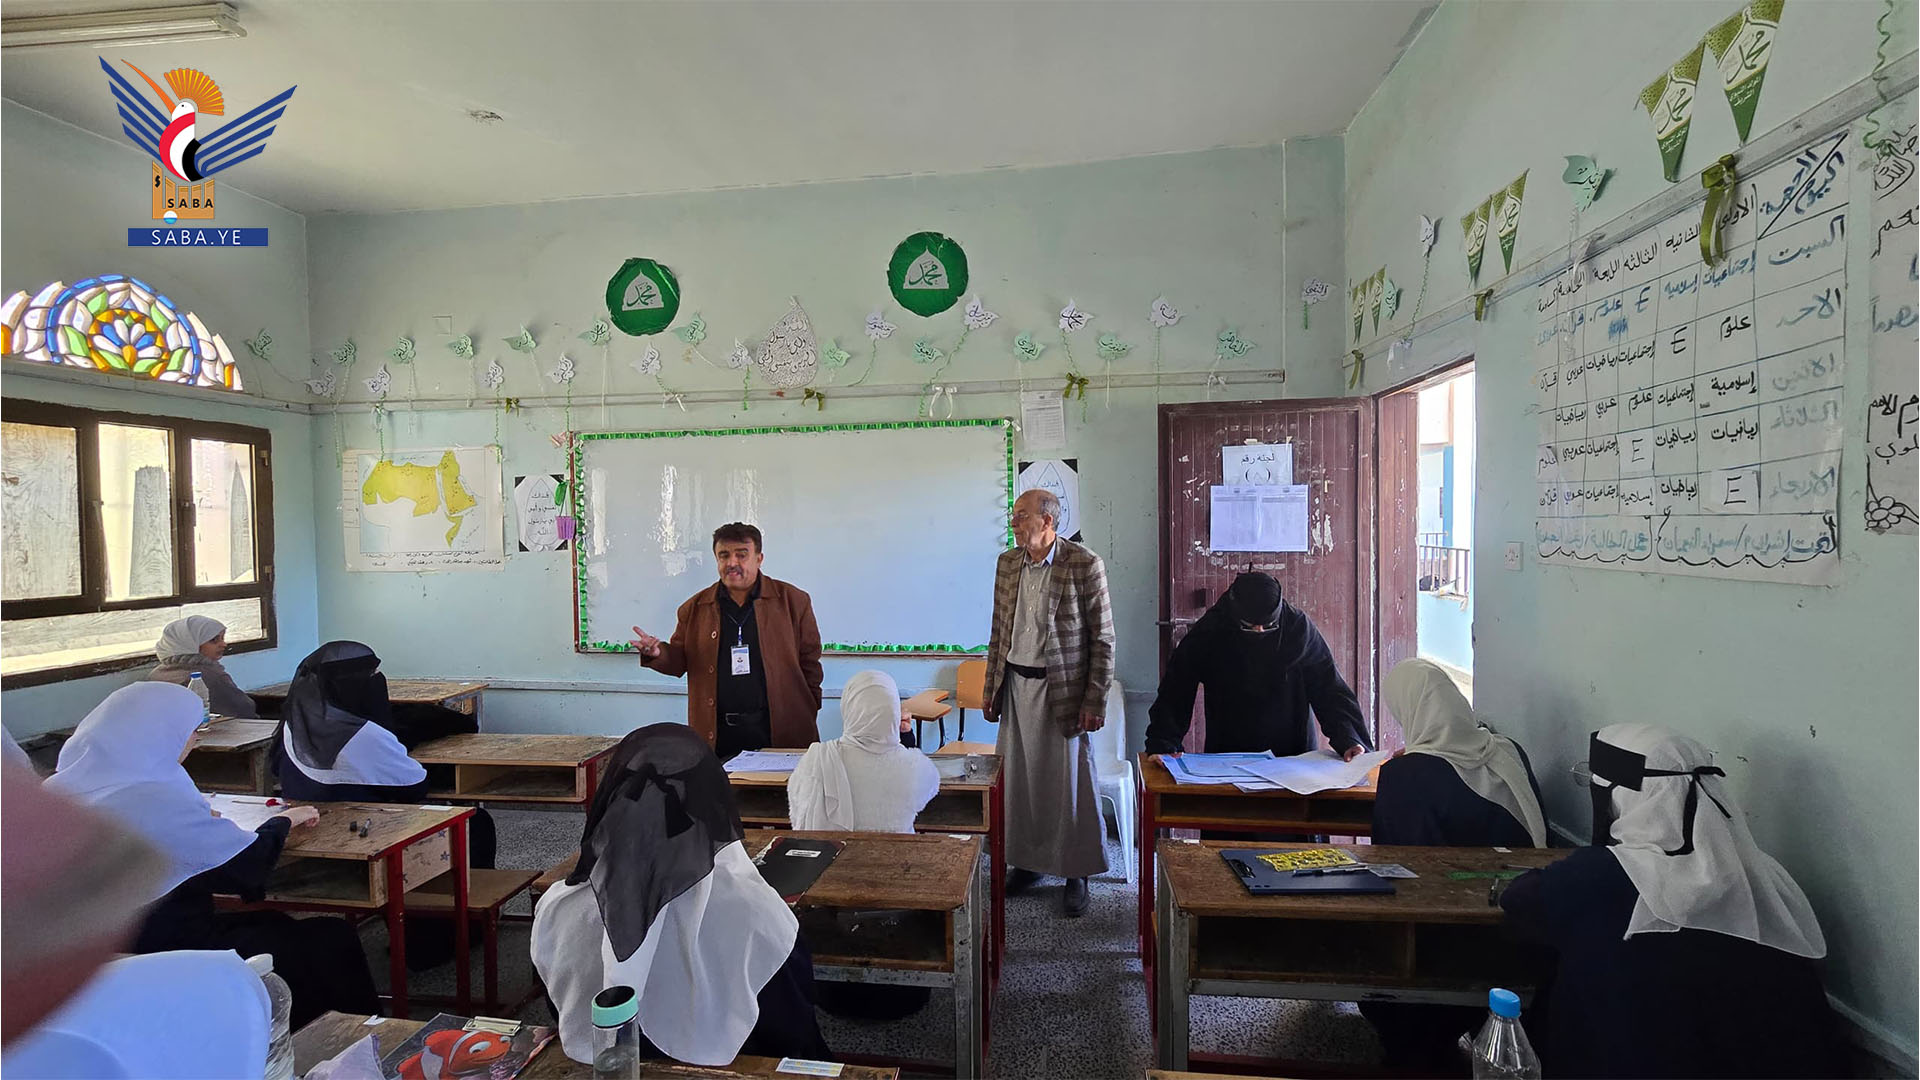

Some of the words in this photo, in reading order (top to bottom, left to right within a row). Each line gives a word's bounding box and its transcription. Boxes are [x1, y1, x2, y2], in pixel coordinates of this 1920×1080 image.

[1768, 215, 1845, 265] السبت
[1671, 326, 1688, 354] E
[1720, 315, 1751, 341] علوم
[1629, 392, 1653, 415] علوم
[1240, 454, 1256, 466] رقم
[1632, 438, 1645, 462] E
[1724, 476, 1746, 505] E
